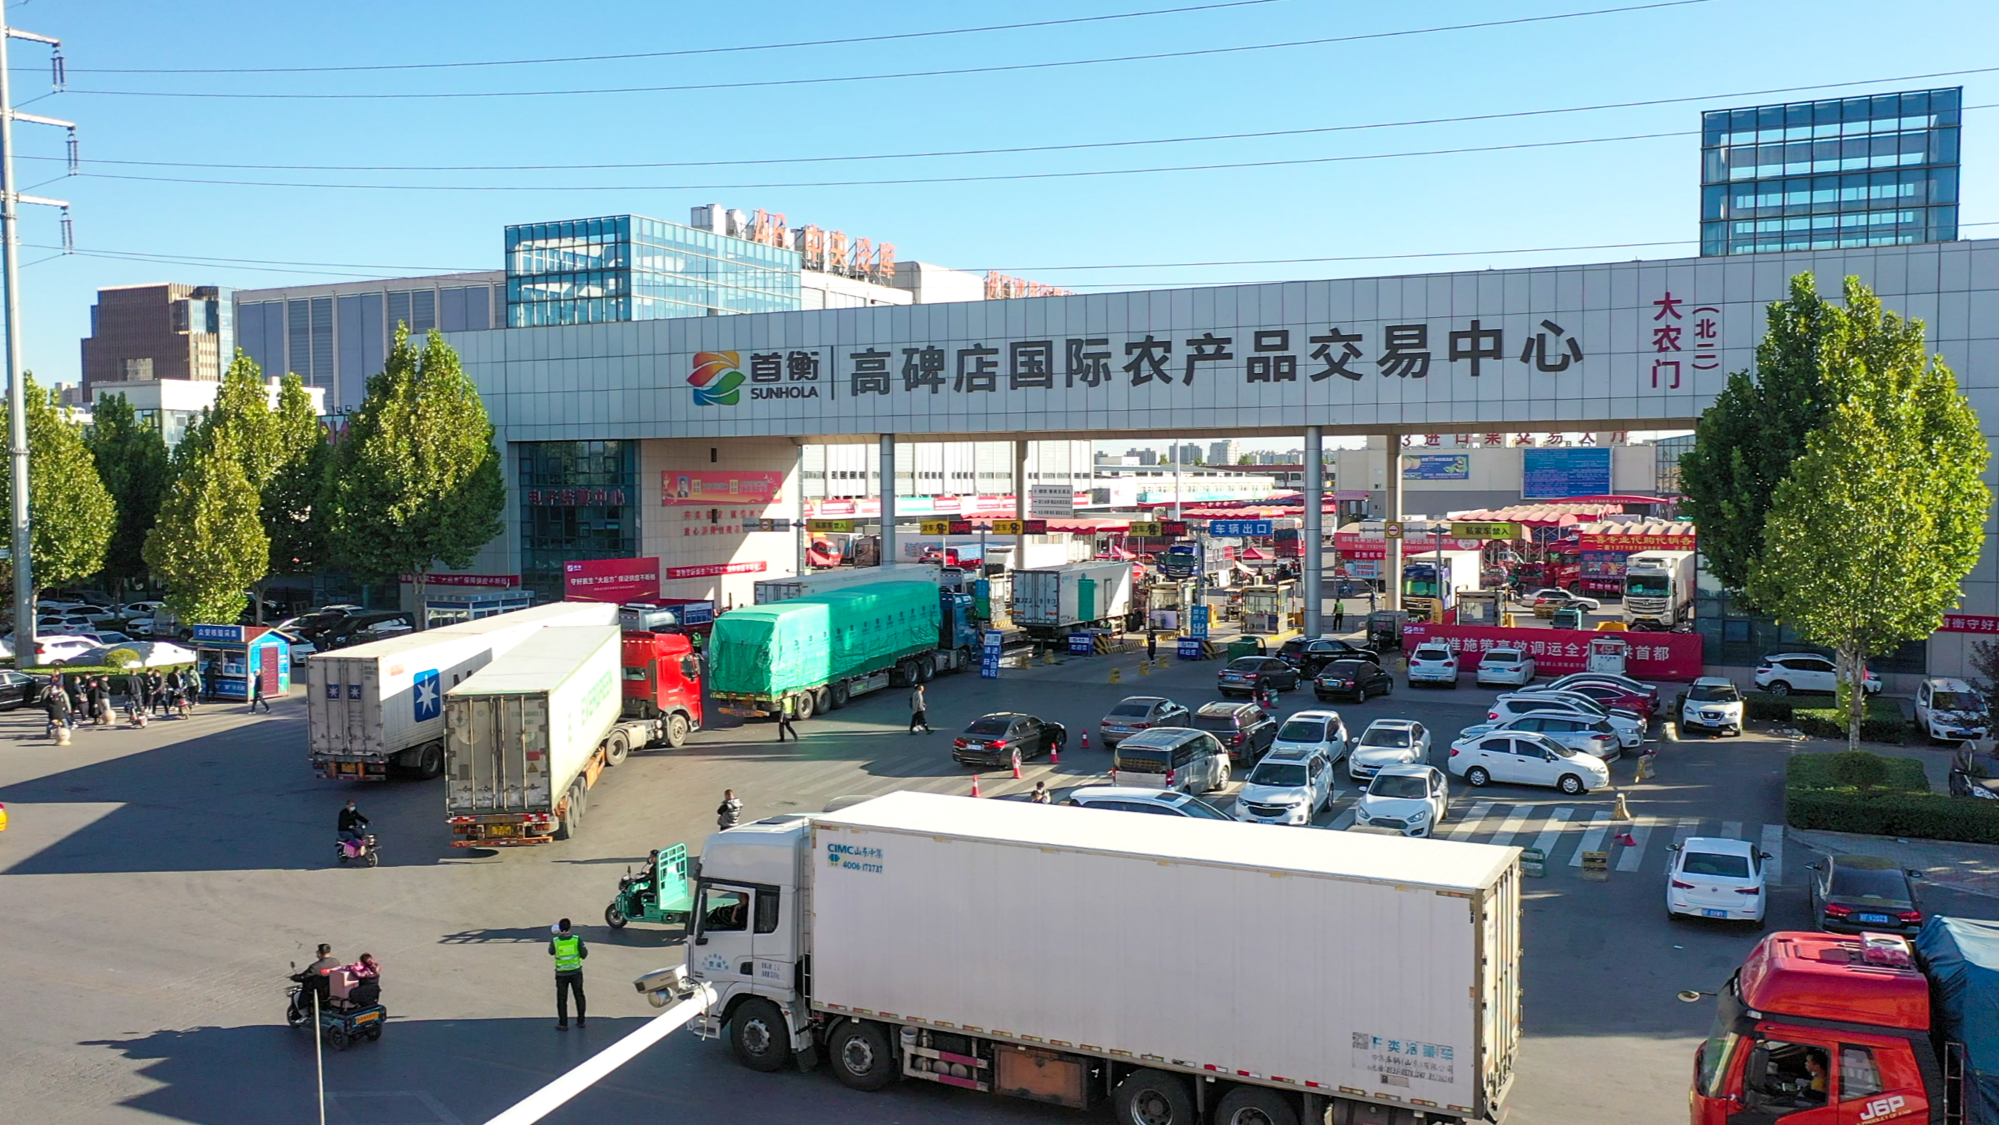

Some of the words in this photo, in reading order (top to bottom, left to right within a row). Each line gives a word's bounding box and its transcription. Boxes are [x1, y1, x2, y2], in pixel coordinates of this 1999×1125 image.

[1652, 293, 1683, 389] 大农门
[850, 319, 1583, 396] 高碑店国际农产品交易中心
[750, 351, 819, 383] 首衡
[750, 387, 819, 400] SUNHOLA
[528, 489, 625, 506] 电子结算中心
[1215, 523, 1267, 535] 车辆出口
[1465, 527, 1510, 539] 私家车禁入
[1192, 622, 1205, 640] 出
[1430, 635, 1670, 662] 精准施策高效调运全力保供首都
[827, 843, 854, 855] CIMC
[1860, 1095, 1905, 1120] J6P
